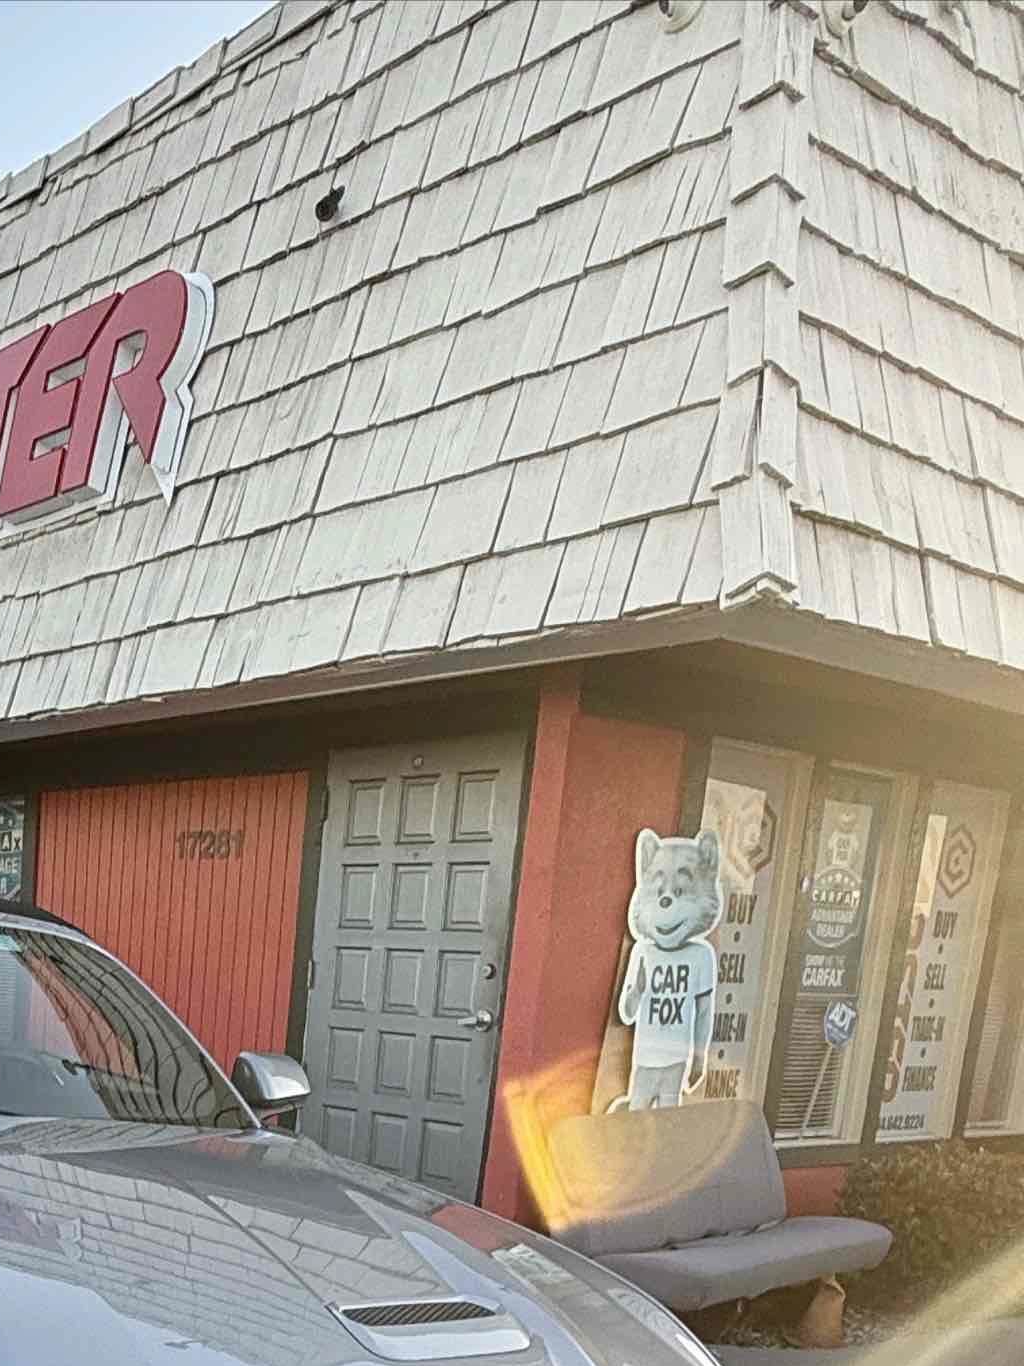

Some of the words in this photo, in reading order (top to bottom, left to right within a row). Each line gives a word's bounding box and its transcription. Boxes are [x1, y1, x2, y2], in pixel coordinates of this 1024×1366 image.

[727, 893, 758, 924] BUY
[933, 910, 958, 939] BUY
[651, 964, 690, 993] CAR
[718, 953, 746, 984] SELL
[802, 967, 846, 987] CARFAX
[924, 963, 947, 990] SELL
[648, 996, 687, 1026] FOX
[828, 1001, 857, 1031] ADT
[712, 1013, 748, 1042] ADE-IN
[704, 1068, 740, 1098] NANCE
